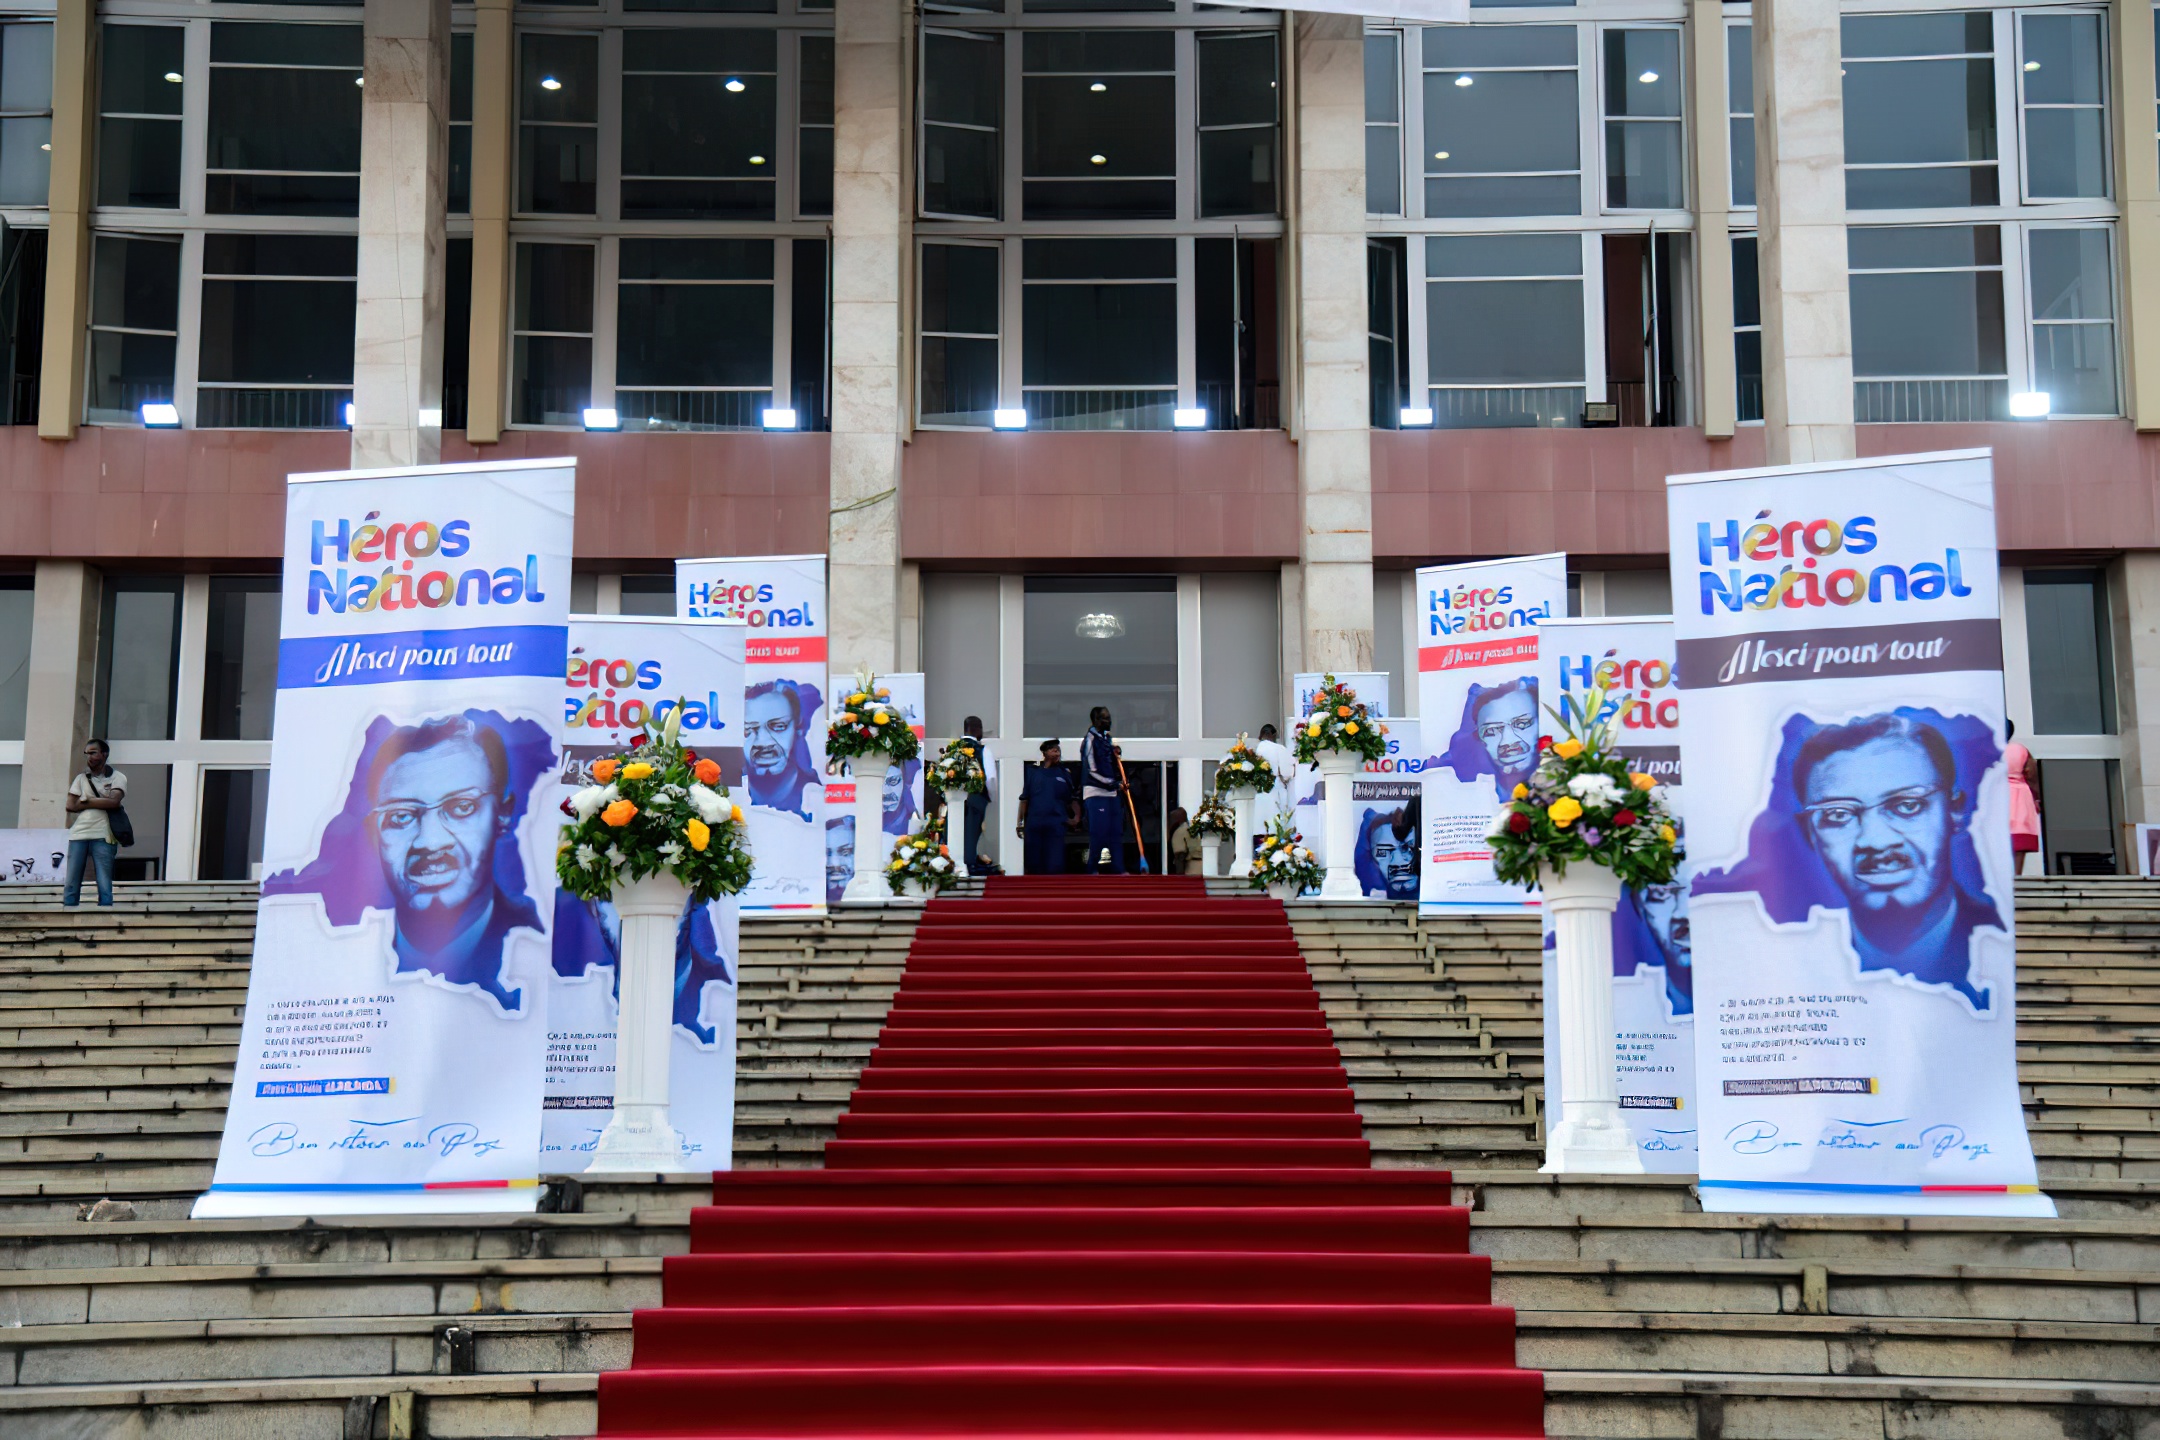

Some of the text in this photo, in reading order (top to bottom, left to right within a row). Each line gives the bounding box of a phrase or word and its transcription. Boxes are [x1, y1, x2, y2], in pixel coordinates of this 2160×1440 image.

[311, 511, 470, 566] Héros
[1697, 509, 1878, 566] Héros
[307, 554, 545, 615] National
[689, 579, 774, 605] Héros
[1430, 584, 1513, 611] Héros
[1700, 548, 1972, 616] National
[566, 646, 662, 691] éros
[565, 688, 726, 731] ational
